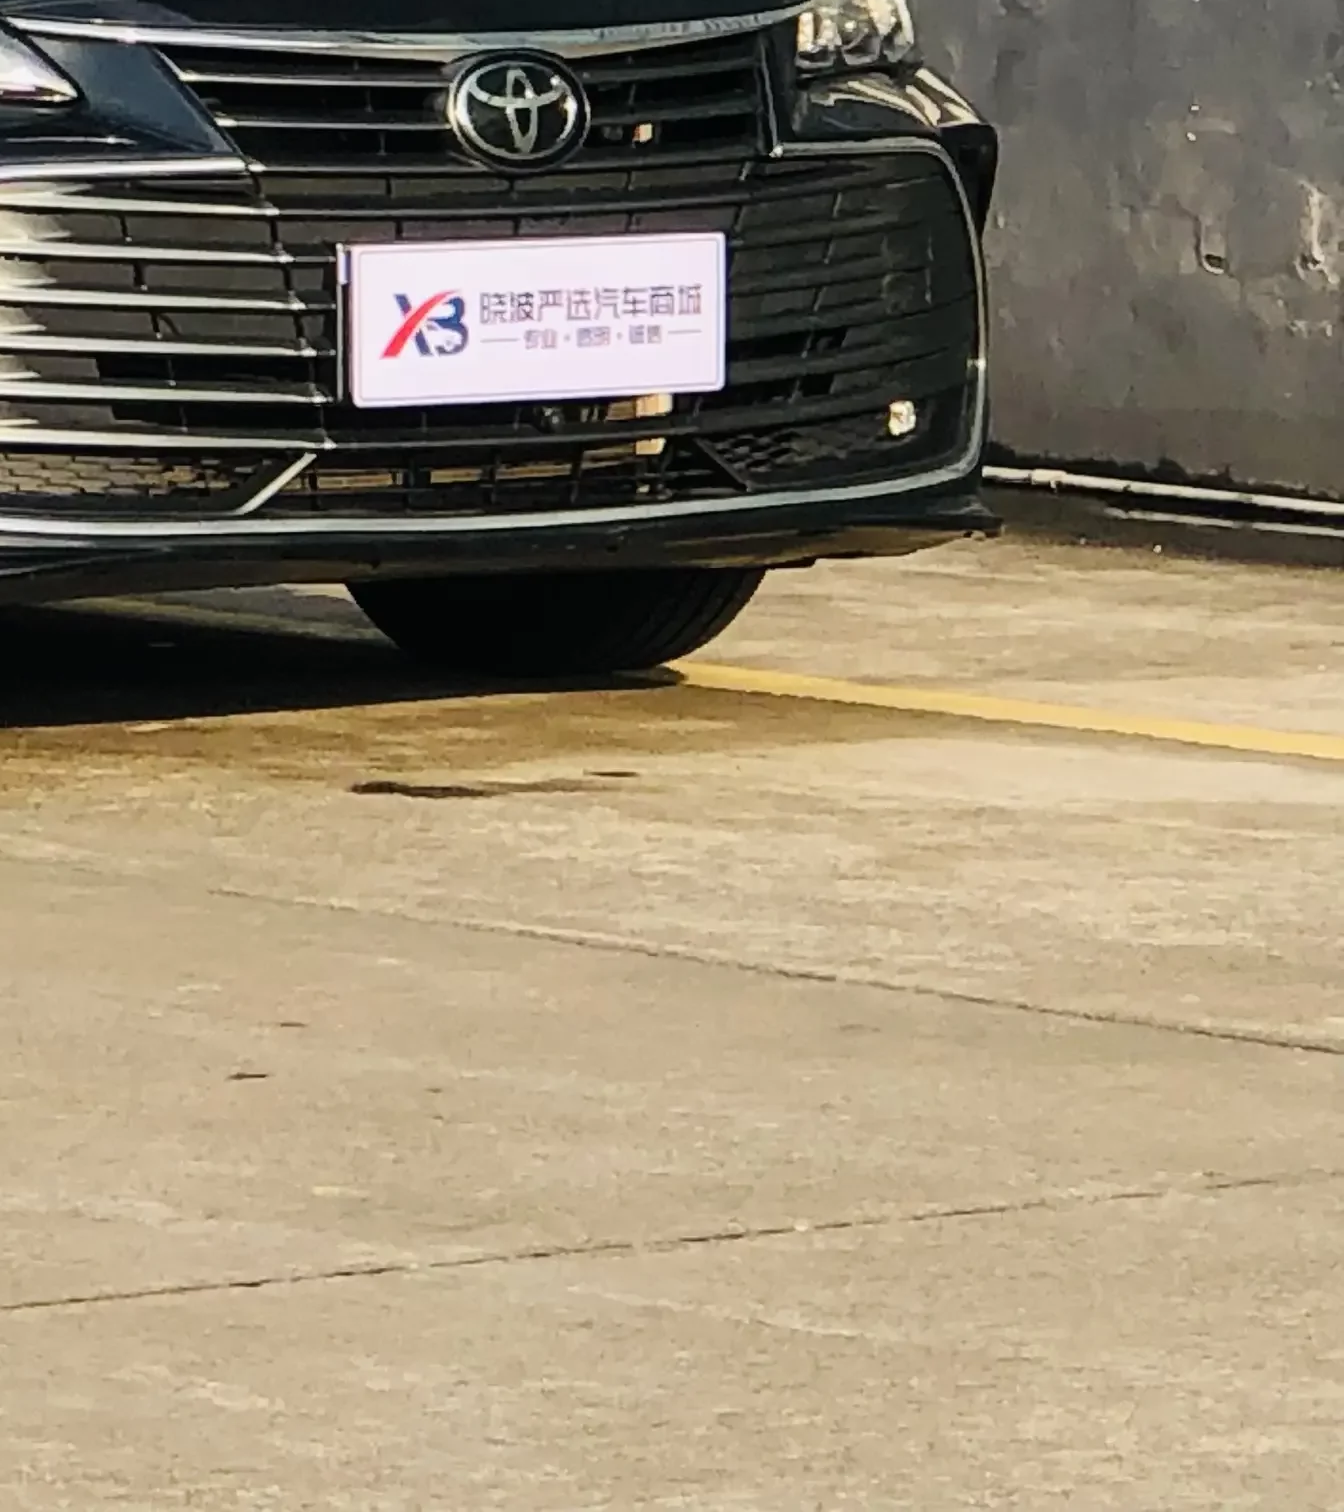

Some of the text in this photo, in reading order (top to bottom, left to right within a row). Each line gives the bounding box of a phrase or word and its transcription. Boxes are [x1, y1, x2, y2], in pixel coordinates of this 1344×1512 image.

[480, 284, 703, 325] 晓波严选汽车商城
